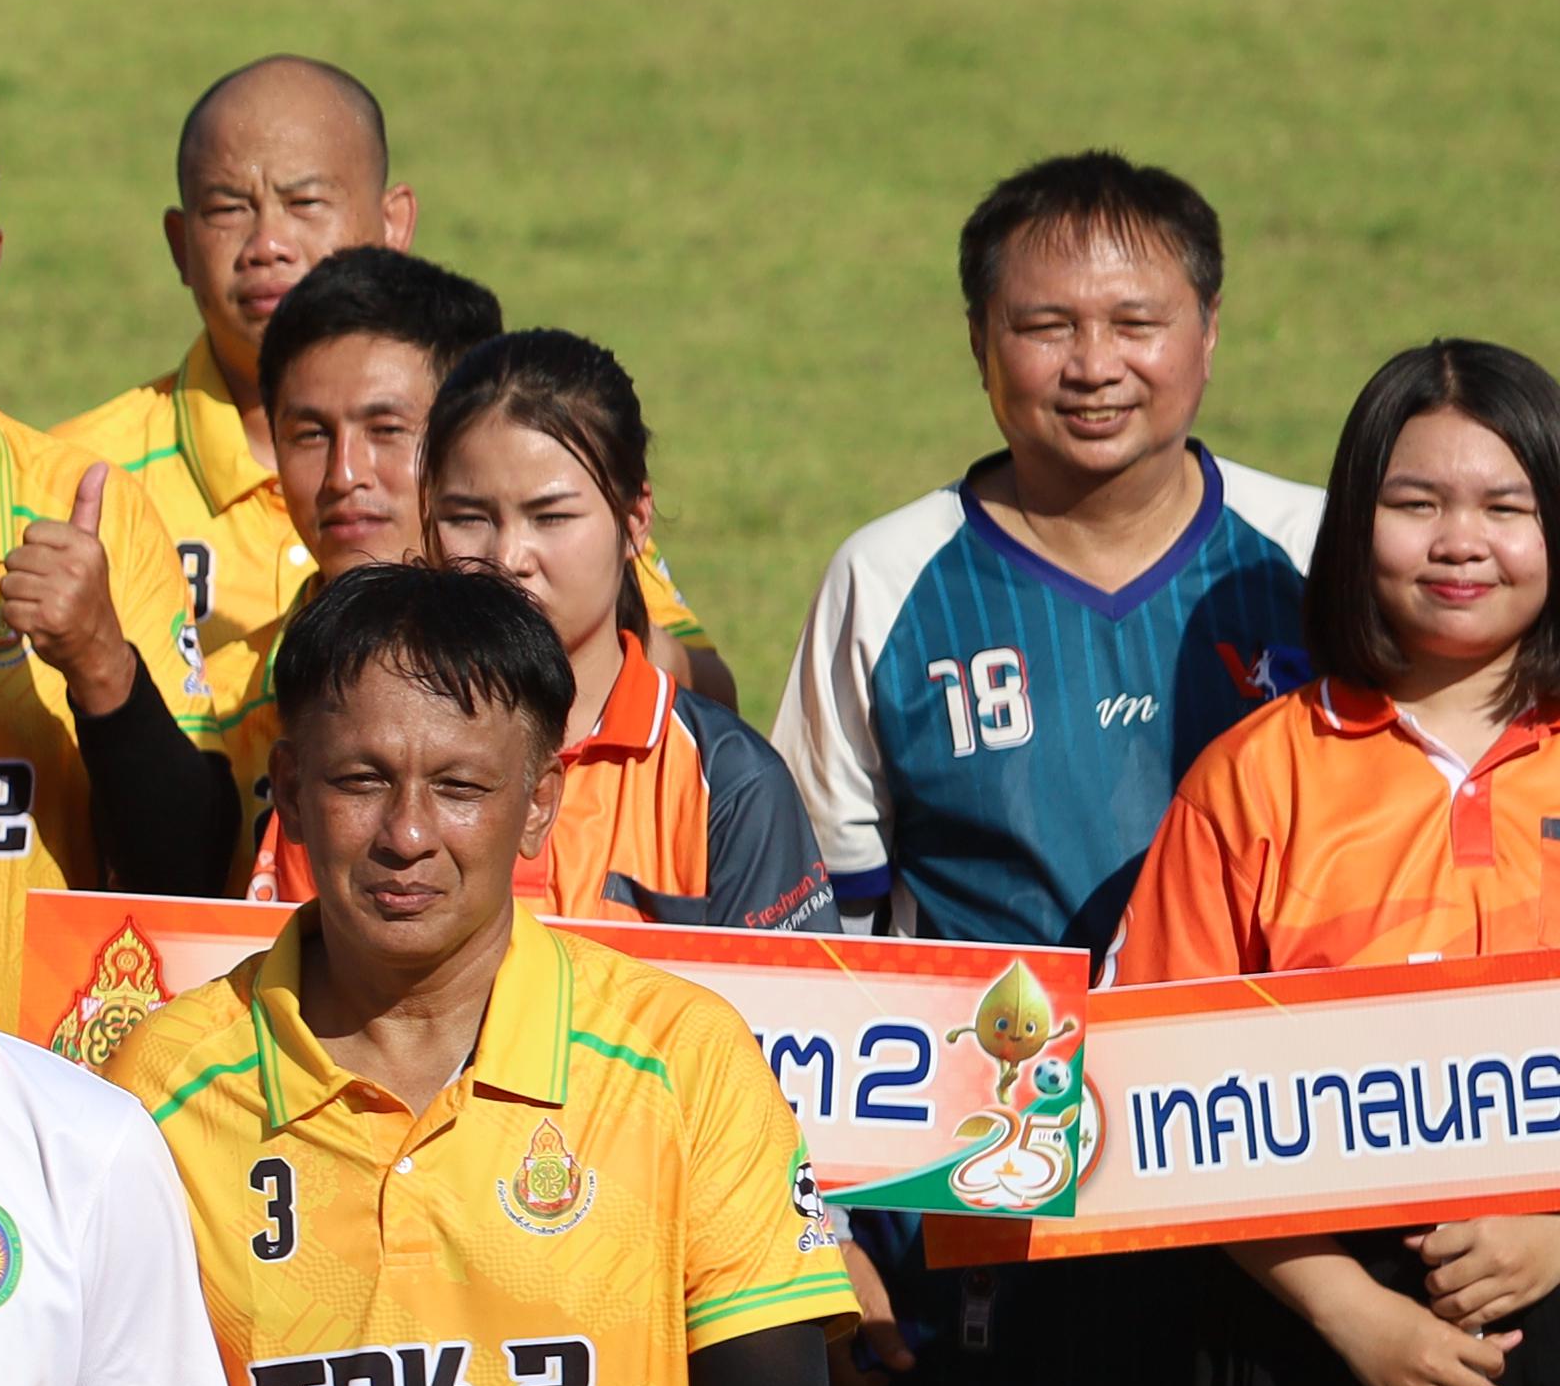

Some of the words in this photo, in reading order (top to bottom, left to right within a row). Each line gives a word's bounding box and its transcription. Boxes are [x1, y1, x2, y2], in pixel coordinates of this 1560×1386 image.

[927, 645, 1035, 759] 18
[855, 1024, 932, 1123] 2
[249, 1157, 296, 1261] 3
